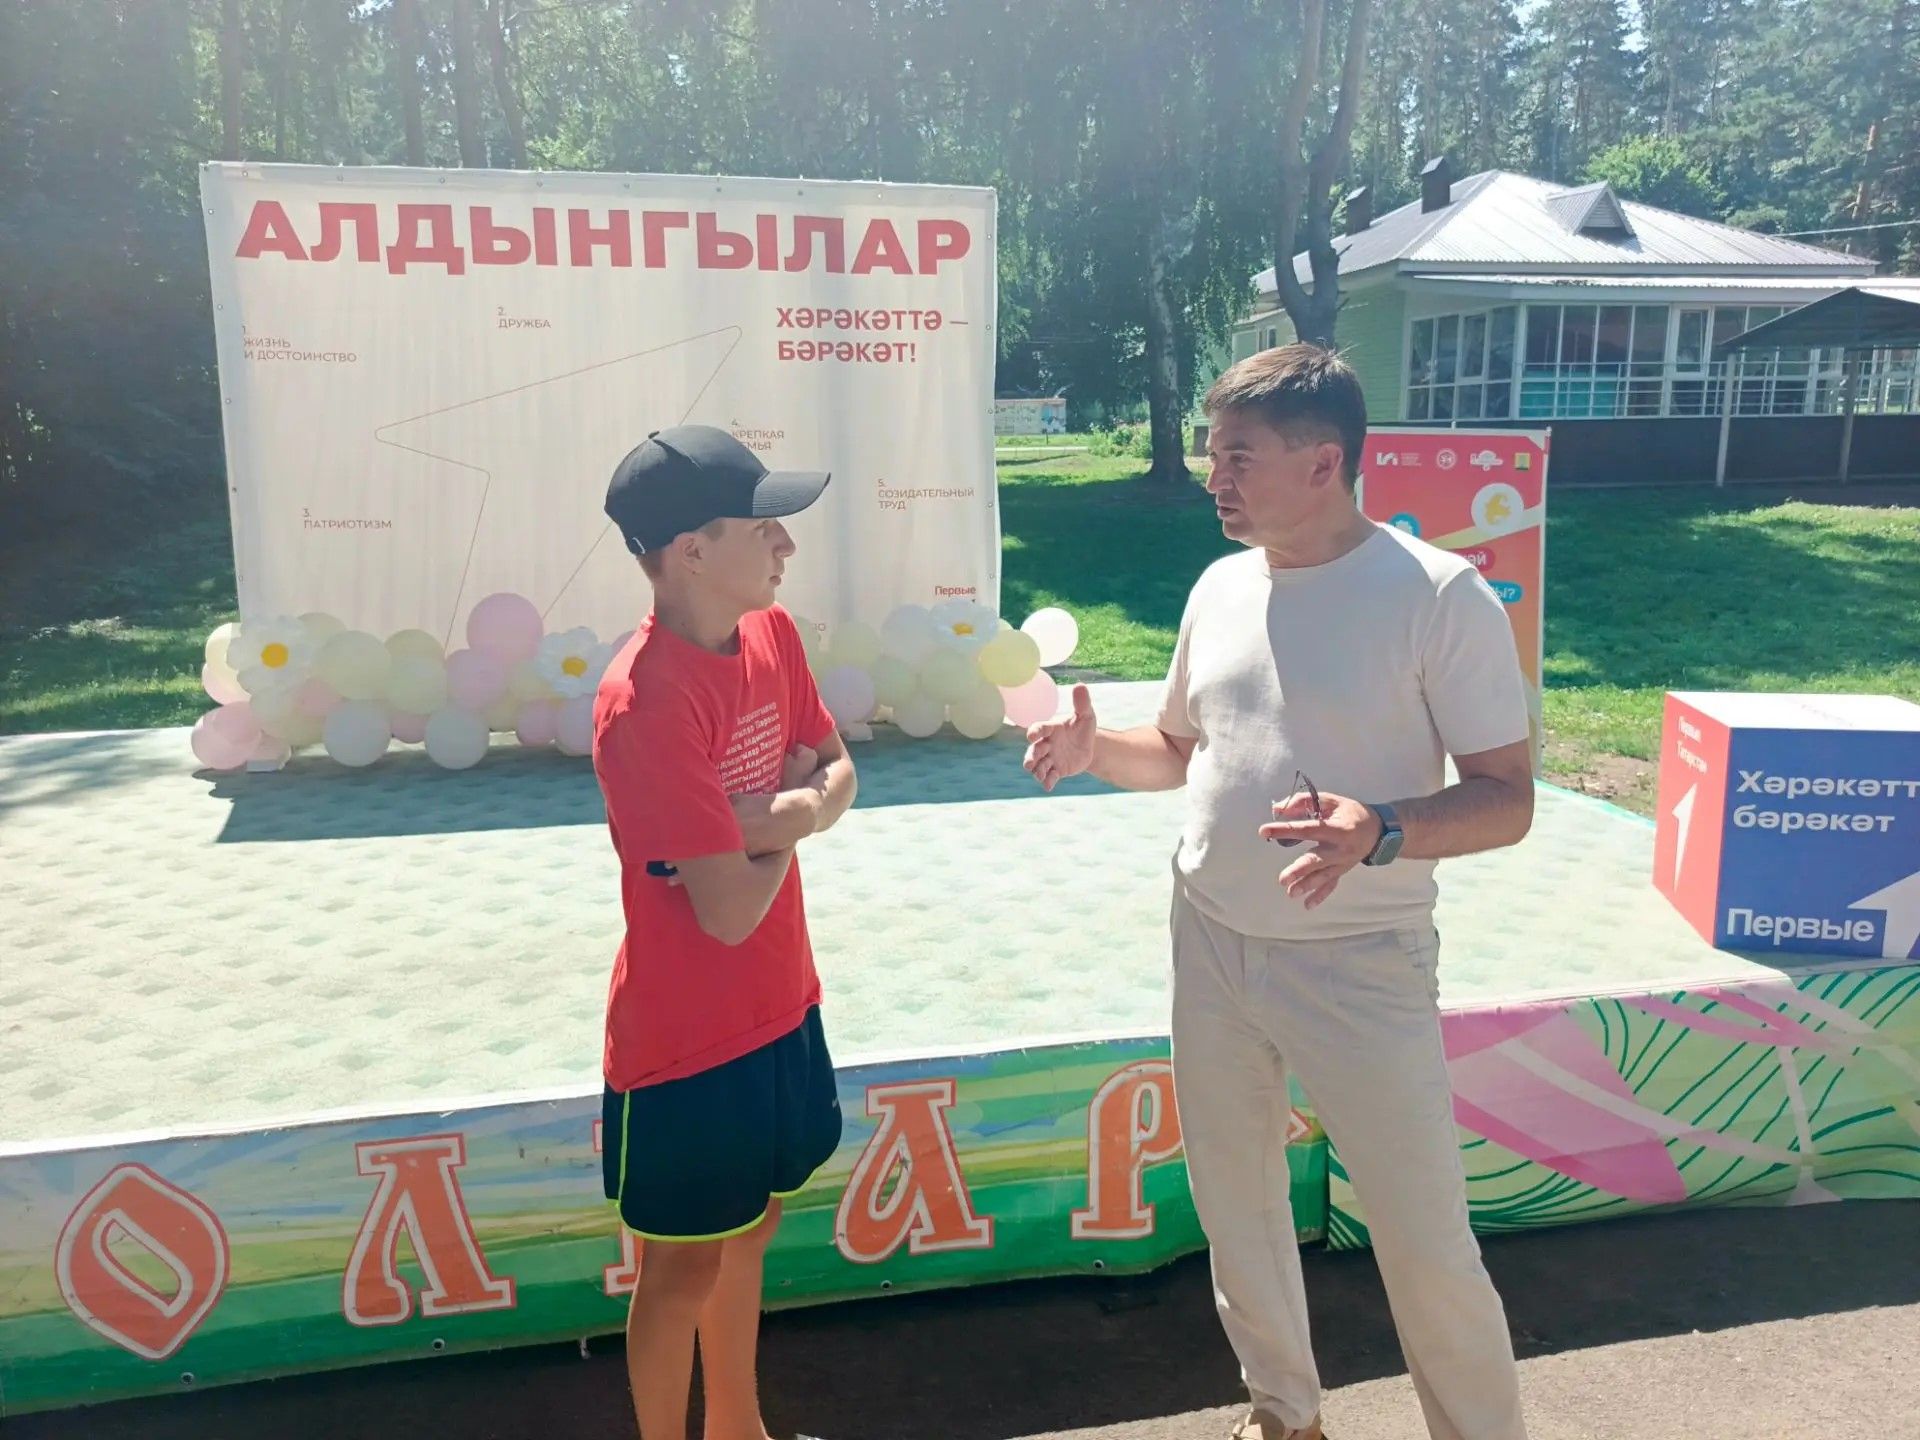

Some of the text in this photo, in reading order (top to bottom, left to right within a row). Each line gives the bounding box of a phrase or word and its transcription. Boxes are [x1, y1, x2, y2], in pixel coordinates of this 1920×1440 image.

[235, 200, 971, 275] АЛДЫНГЫЛАР
[498, 318, 552, 329] ДРУЖБА
[777, 307, 942, 331] ХӘРӘКӘТТӘ
[243, 338, 291, 348] ЖИЗНЬ
[244, 350, 357, 362] И ДОСТОИНСТВО
[778, 340, 916, 363] БӘРӘКӘТ!
[731, 429, 785, 440] КРЕПКАЯ
[878, 487, 975, 498] СОЗИДАТЕЛЬНЫЙ
[879, 500, 906, 510] ТРУД
[303, 519, 392, 529] ПАТРИОТИЗМ
[935, 585, 976, 598] Первые
[1733, 804, 1895, 834] бәрәкәт
[1726, 907, 1875, 945] Первые
